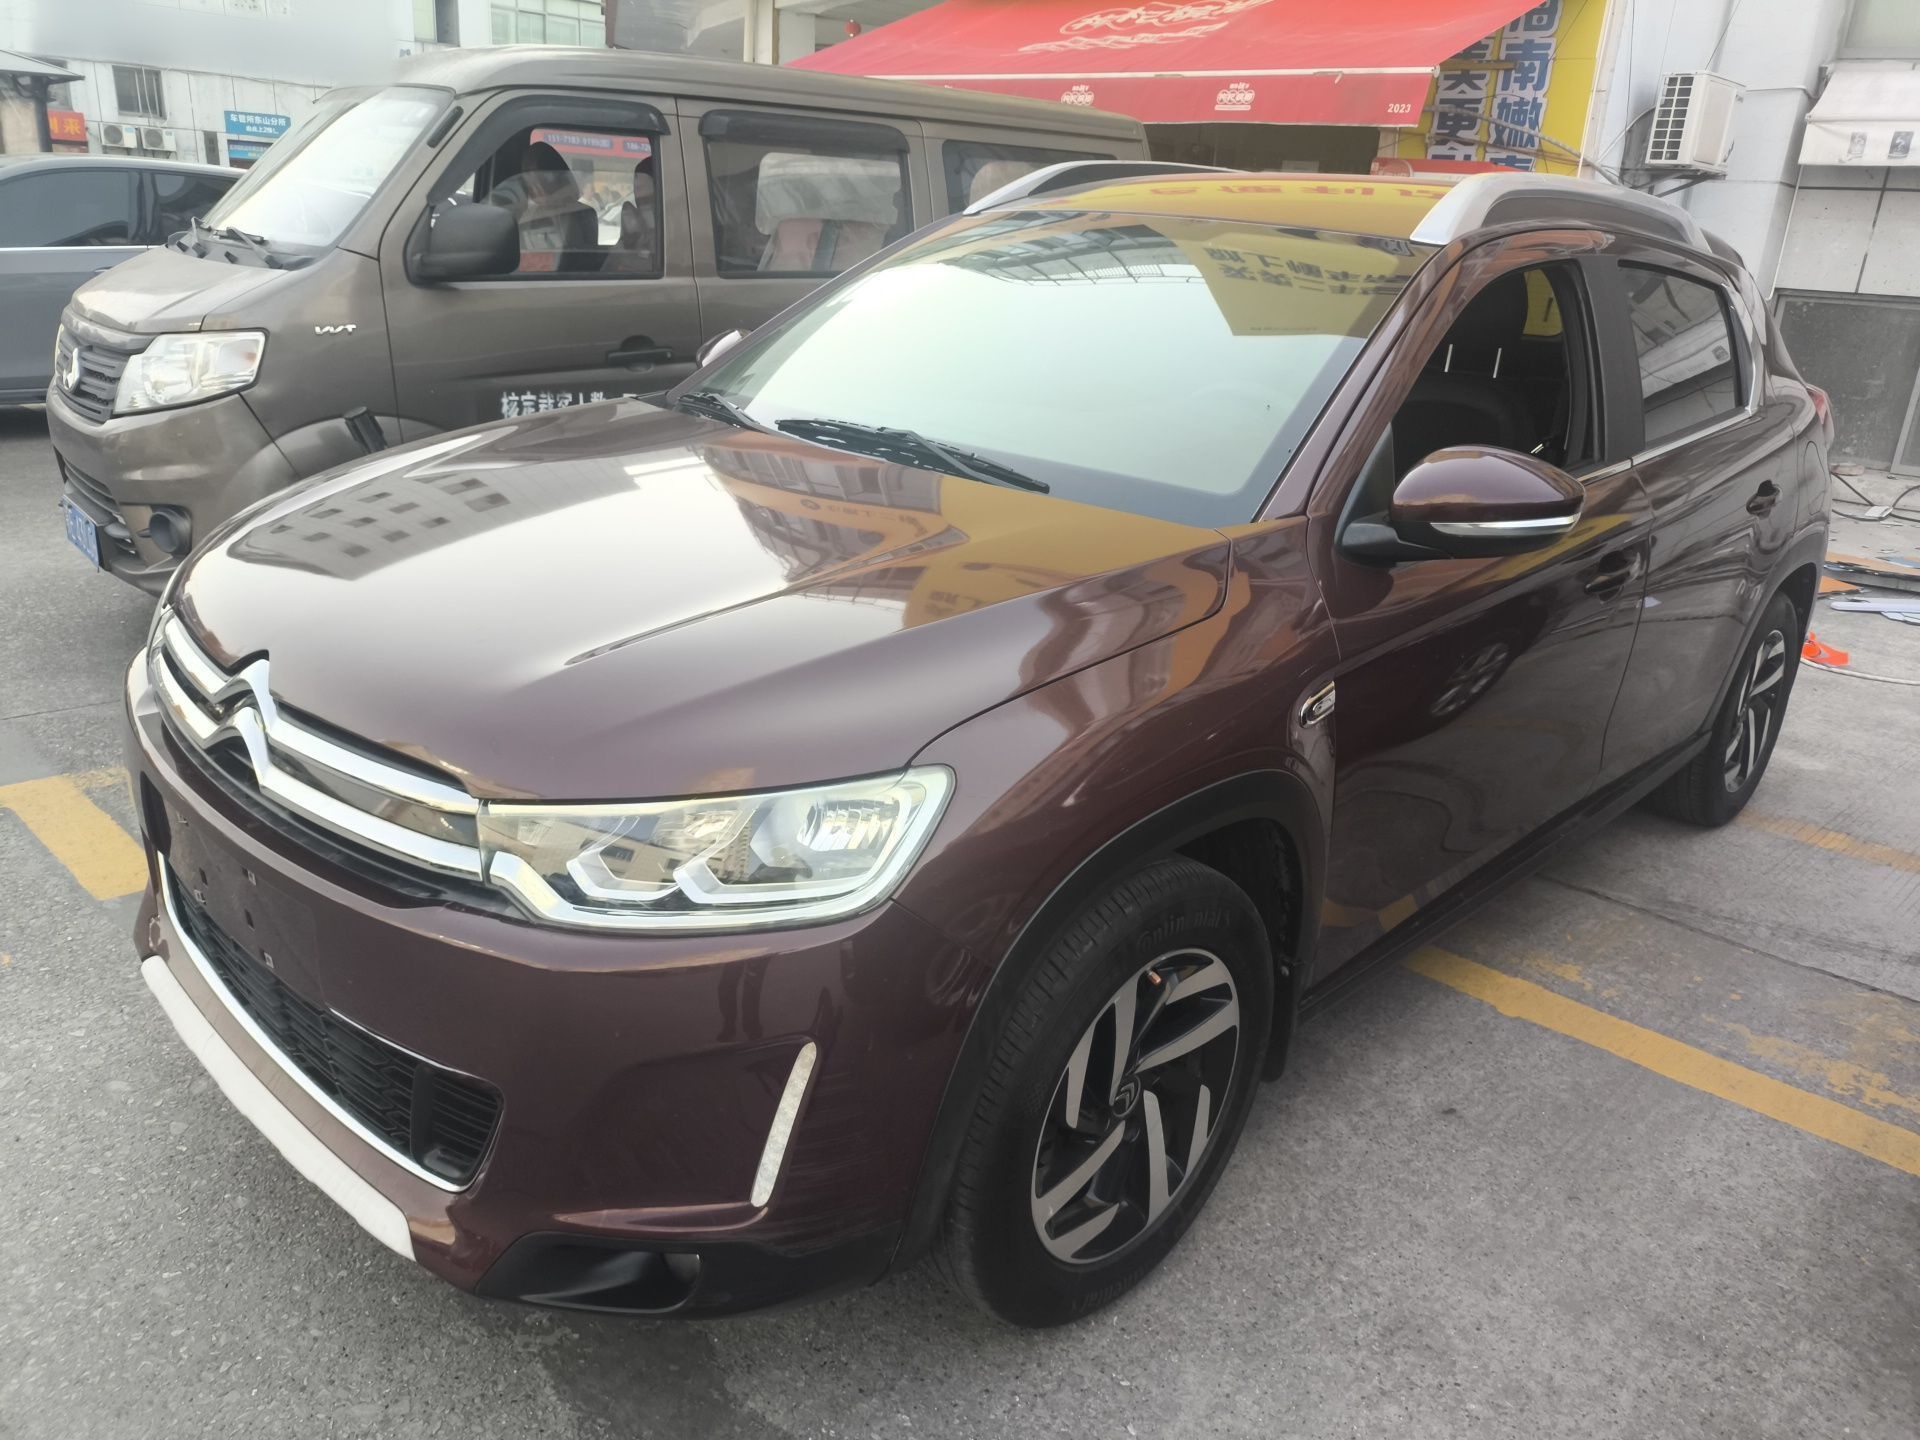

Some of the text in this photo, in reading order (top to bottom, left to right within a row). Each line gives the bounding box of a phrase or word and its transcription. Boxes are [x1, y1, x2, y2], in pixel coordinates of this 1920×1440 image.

[1387, 103, 1412, 114] 2023
[1431, 40, 1490, 161] 美更
[1490, 0, 1558, 171] 南嫩
[230, 113, 286, 126] 车管所东山分所
